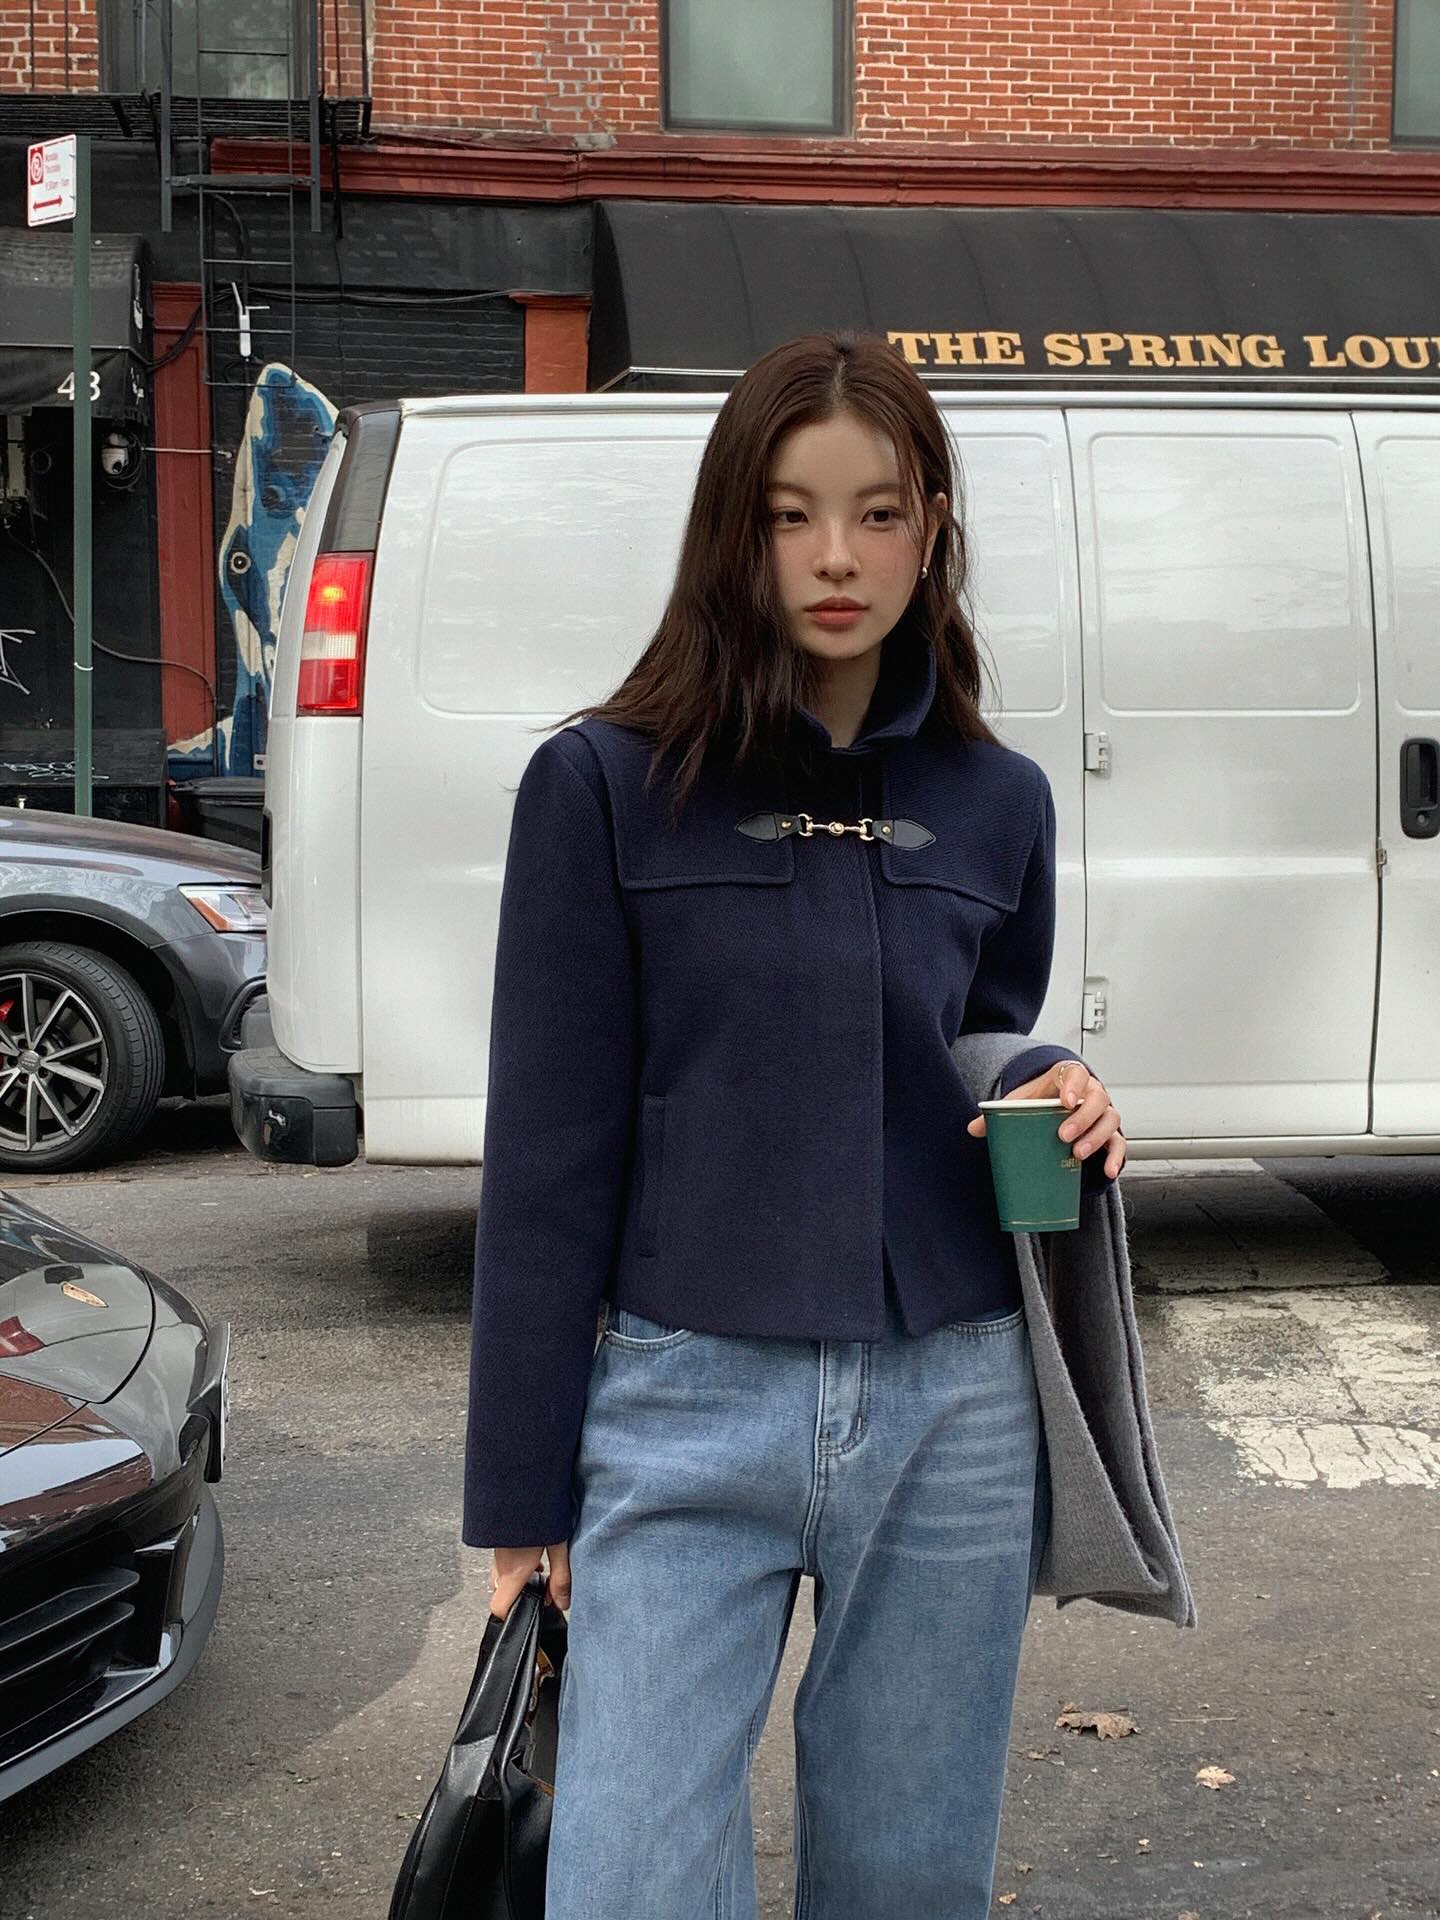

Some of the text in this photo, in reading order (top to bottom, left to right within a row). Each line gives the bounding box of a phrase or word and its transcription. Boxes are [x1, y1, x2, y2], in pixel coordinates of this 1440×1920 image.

[886, 331, 1440, 369] THE SPRING LOU
